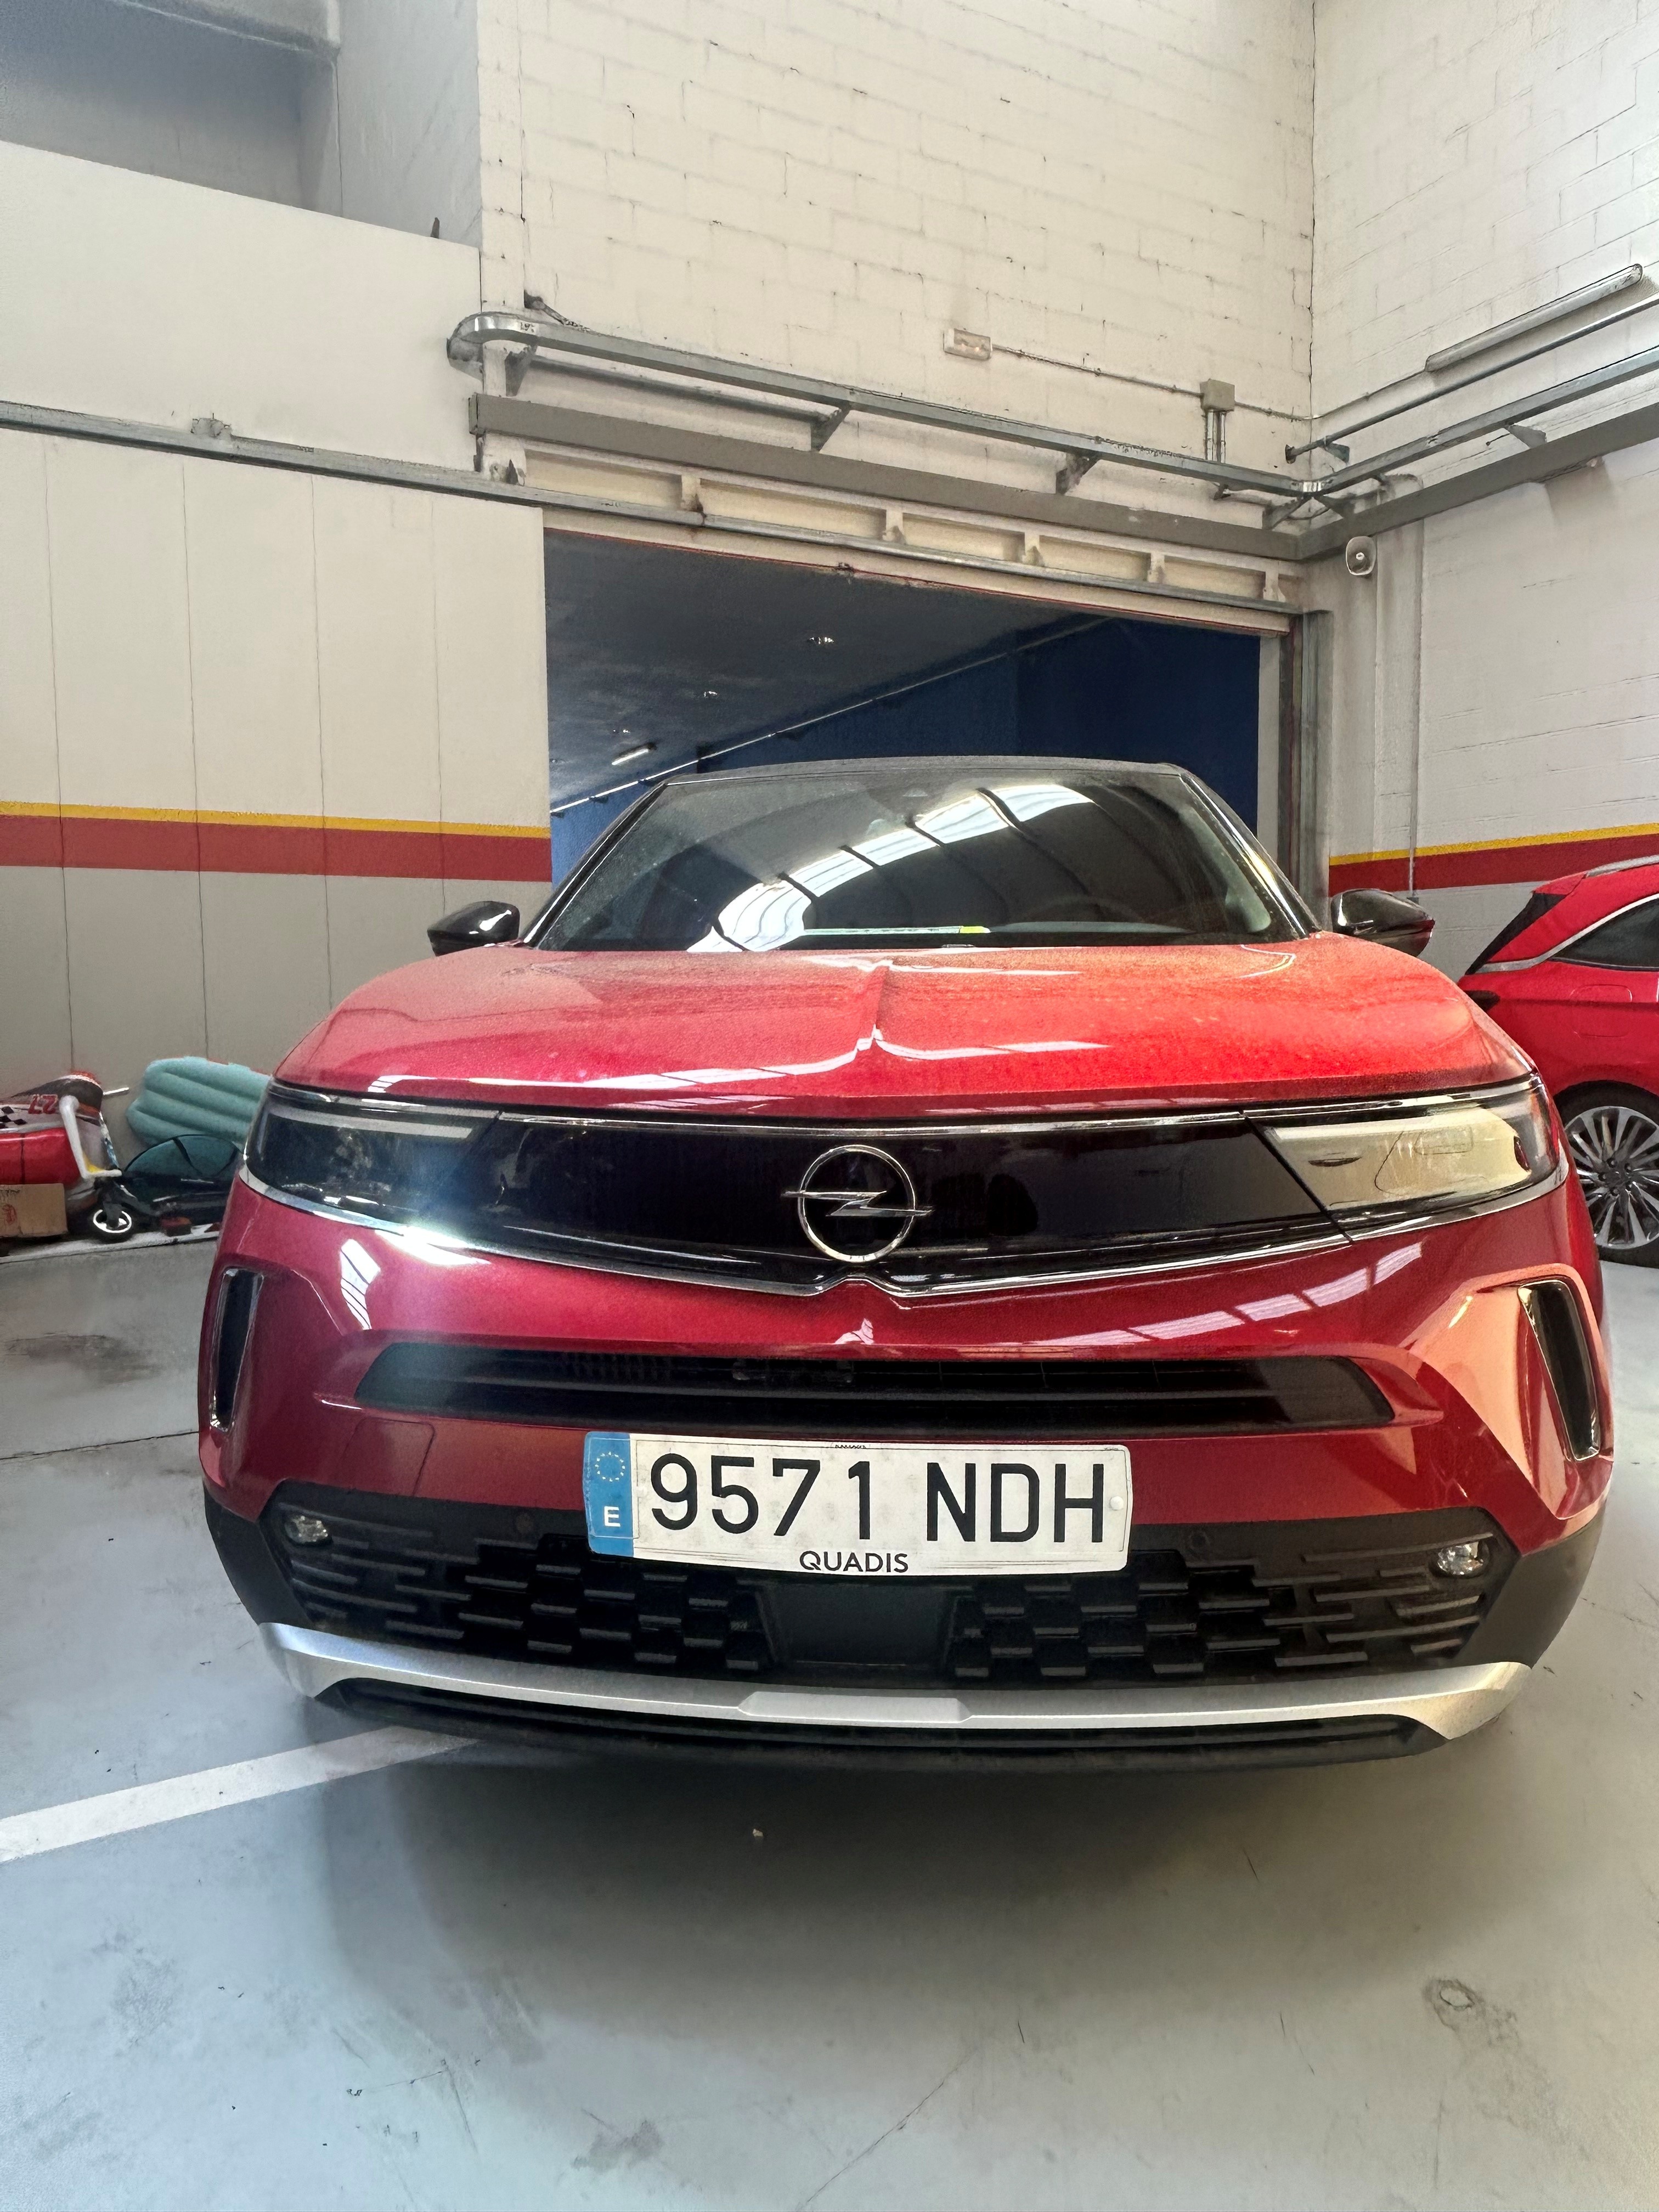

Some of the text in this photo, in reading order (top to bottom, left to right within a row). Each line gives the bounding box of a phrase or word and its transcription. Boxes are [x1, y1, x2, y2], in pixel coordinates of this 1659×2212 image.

[651, 1453, 1104, 1543] 9571 NDH
[604, 1505, 621, 1527] E
[799, 1550, 909, 1573] QUADIS
